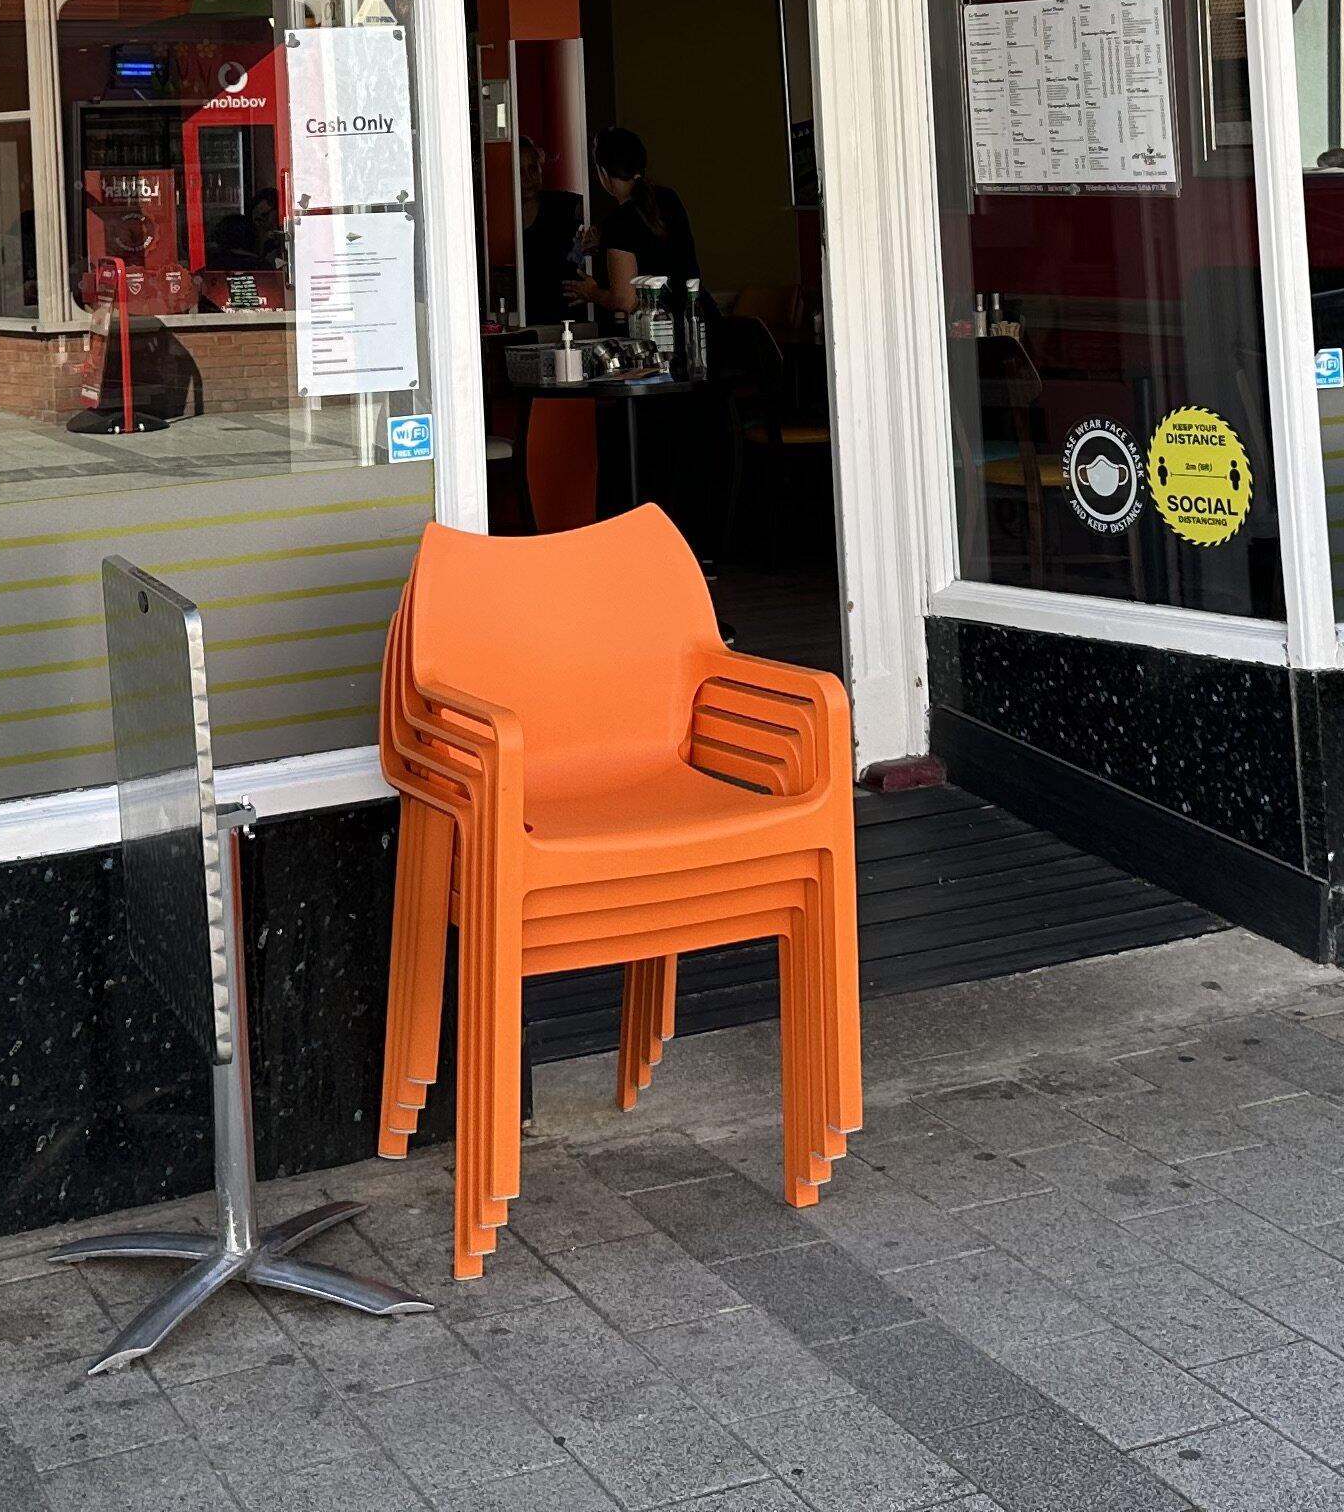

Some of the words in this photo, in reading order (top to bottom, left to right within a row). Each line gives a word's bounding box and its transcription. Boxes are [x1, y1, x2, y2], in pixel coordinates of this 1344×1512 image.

[305, 116, 347, 134] Cash
[352, 113, 394, 134] Only
[1172, 423, 1193, 431] KEEP
[1195, 424, 1217, 433] YOUR
[1062, 435, 1077, 478] PLEASE
[1075, 419, 1101, 436] WEAR
[1104, 420, 1128, 441] FACE
[1127, 442, 1144, 478] MASK
[1166, 433, 1226, 446] DISTANCE
[1167, 494, 1238, 516] SOCIAL
[1069, 499, 1087, 520] AND
[1087, 517, 1108, 533] KEEP
[1110, 499, 1143, 533] DISTANCE
